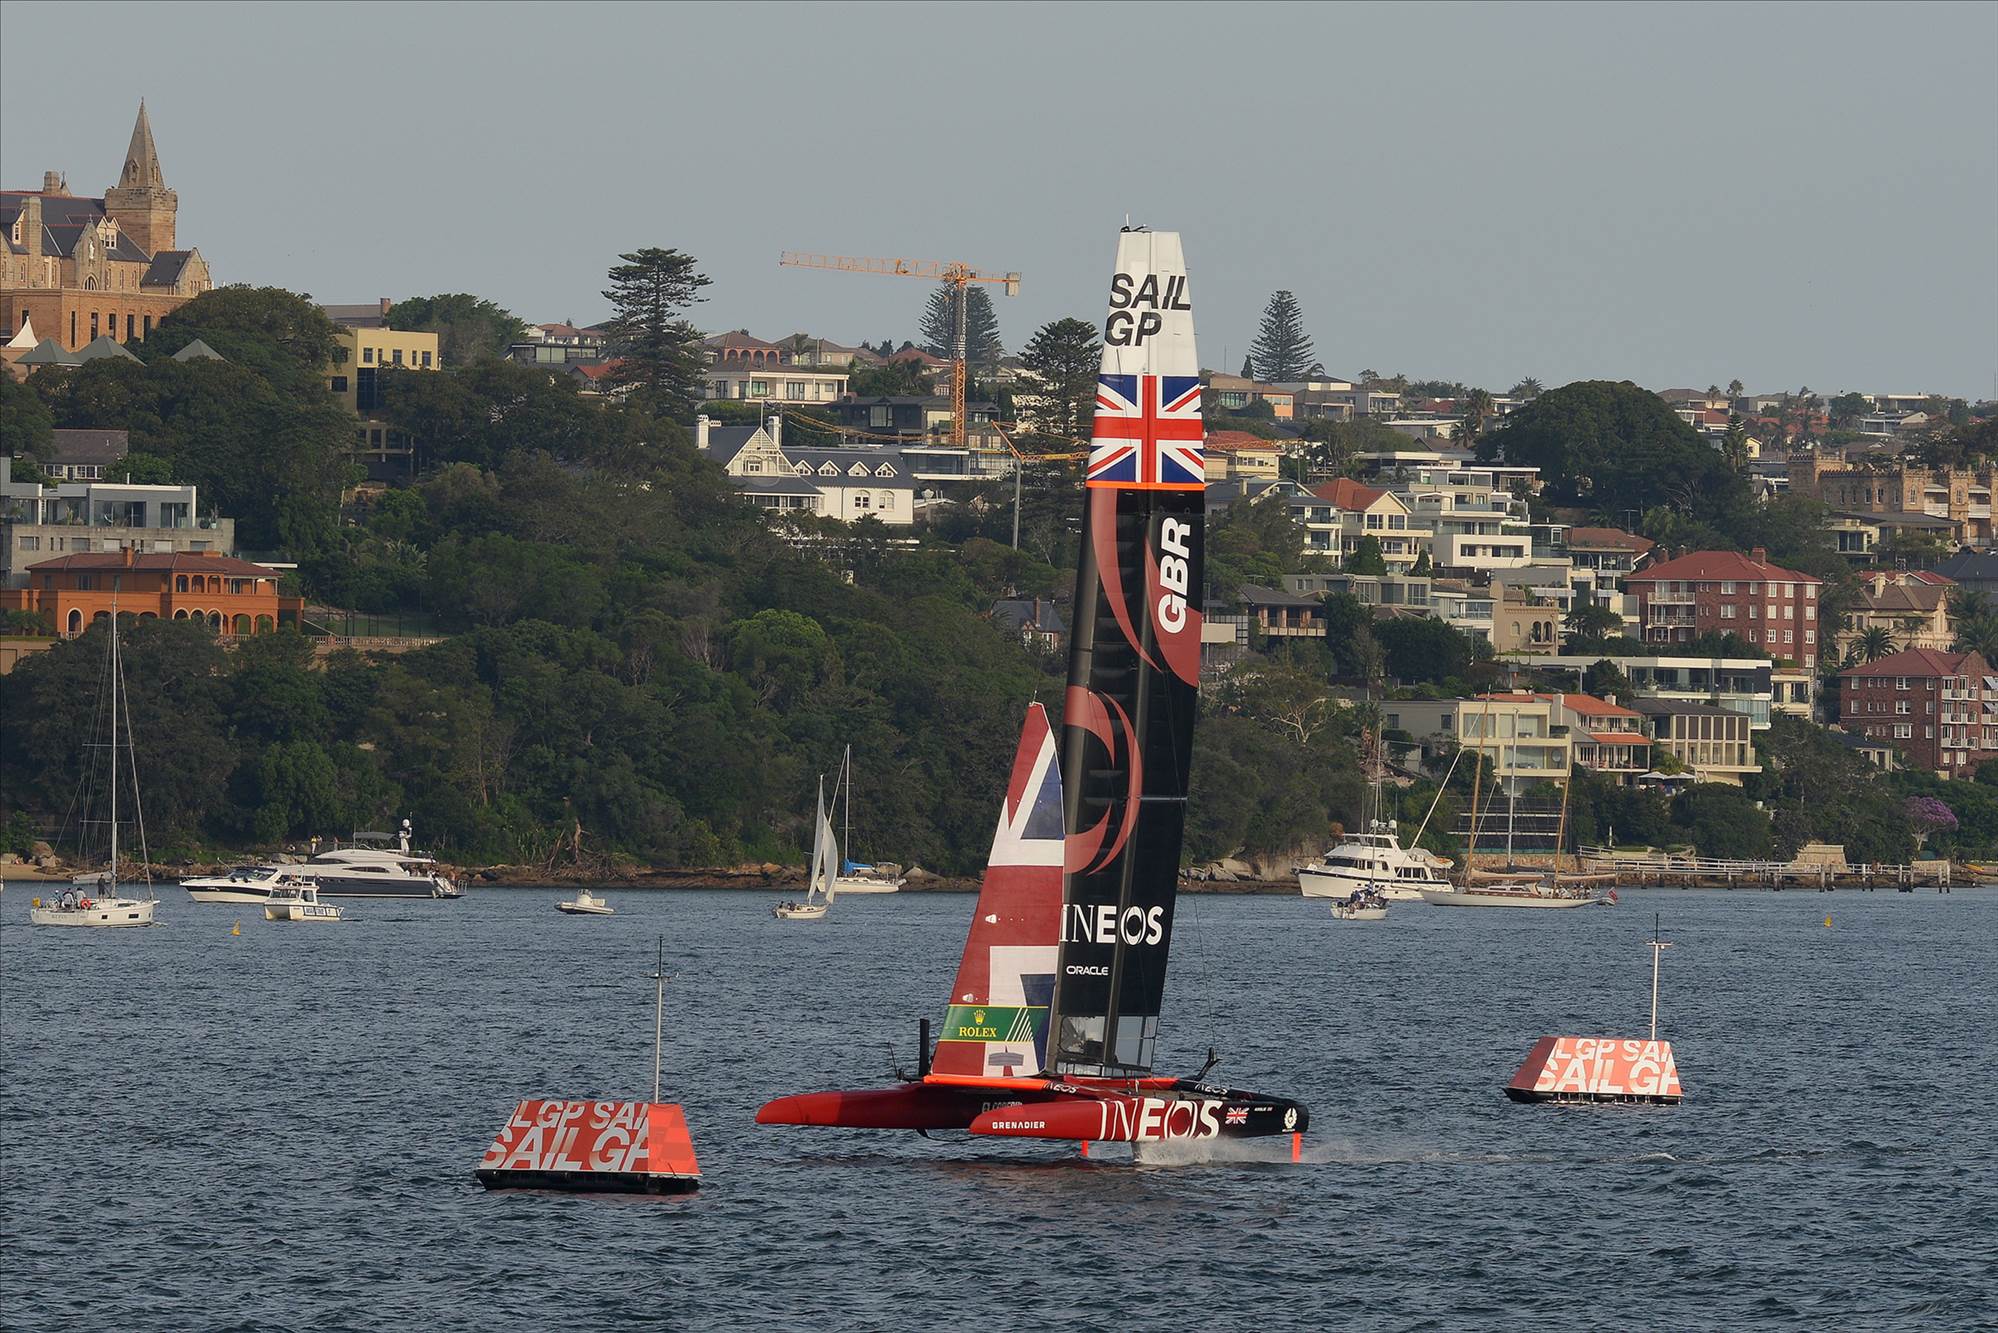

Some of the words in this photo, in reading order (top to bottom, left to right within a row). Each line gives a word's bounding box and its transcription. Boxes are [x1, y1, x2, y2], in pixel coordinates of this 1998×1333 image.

[1109, 273, 1191, 311] SAIL
[1104, 310, 1162, 346] GP
[1157, 517, 1191, 634] GBR
[1059, 903, 1164, 946] INEOS
[1066, 965, 1109, 976] ORACLE
[959, 1026, 997, 1038] ROLEX
[1576, 1038, 1616, 1061] GP
[1533, 1058, 1623, 1093] SAIL
[536, 1101, 585, 1128] GP
[992, 1121, 1045, 1129] GRENADIER
[1096, 1098, 1223, 1141] INEOS
[480, 1126, 583, 1170] SAIL
